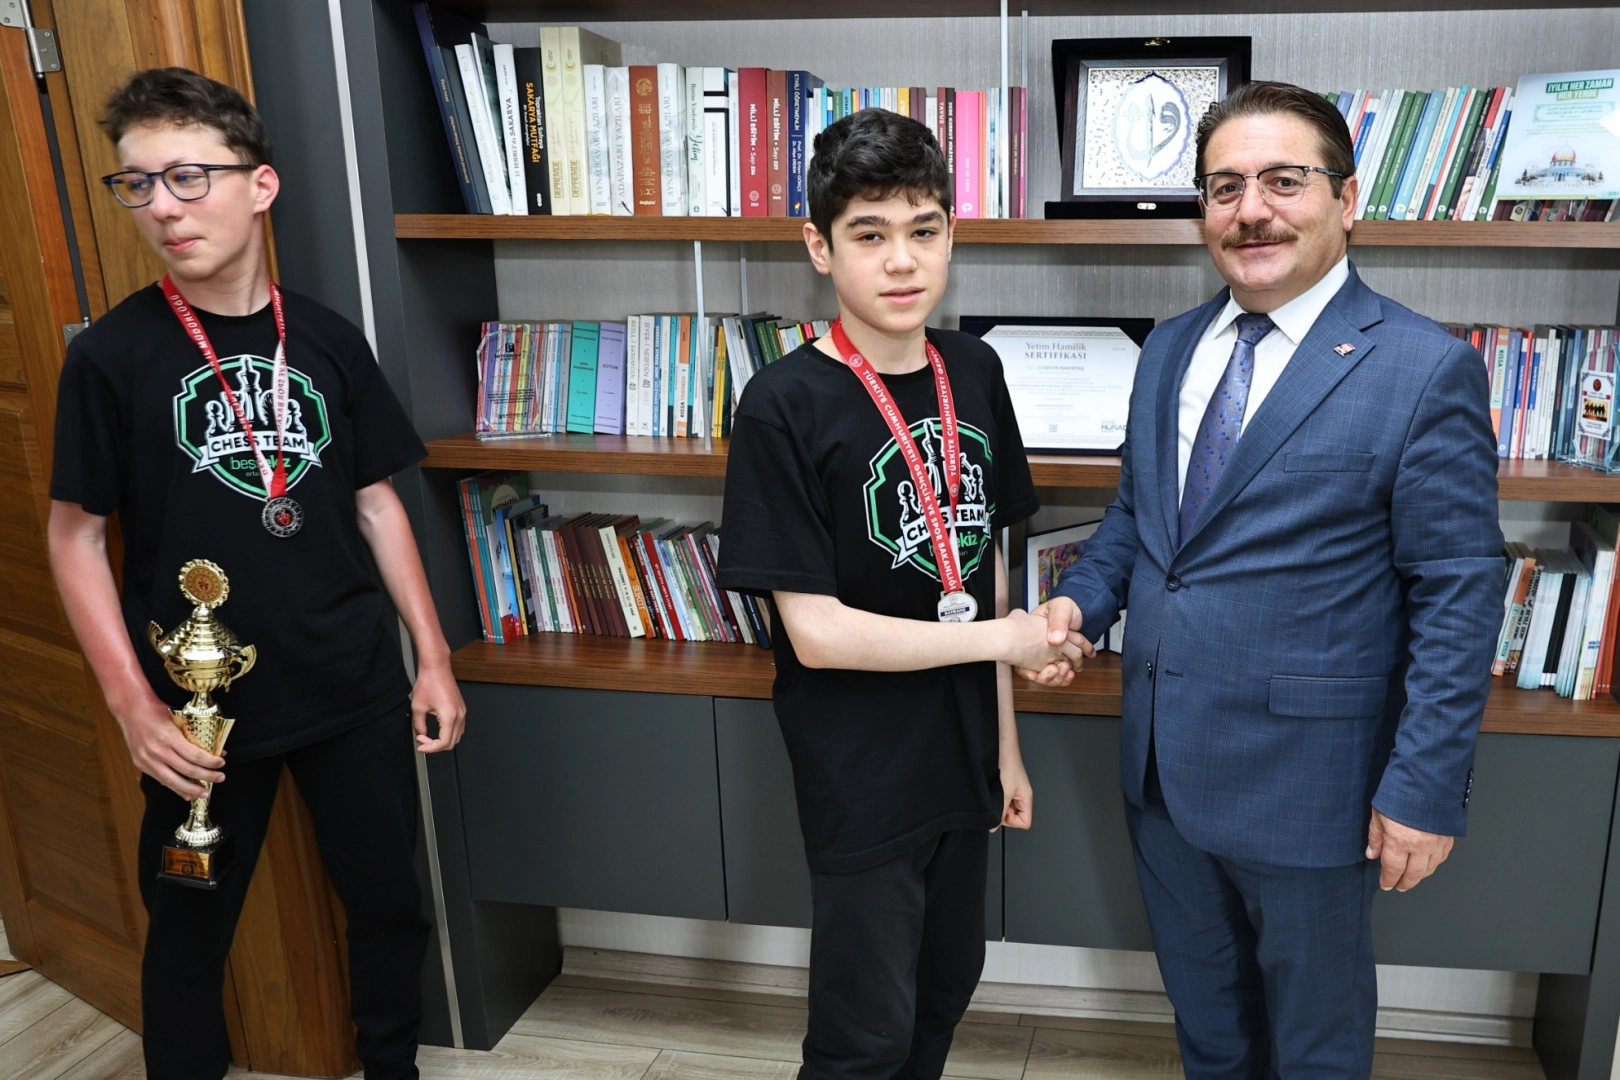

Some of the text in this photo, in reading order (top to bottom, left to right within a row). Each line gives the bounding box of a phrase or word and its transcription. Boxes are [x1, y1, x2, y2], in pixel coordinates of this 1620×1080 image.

[1569, 81, 1585, 91] HER
[1585, 79, 1613, 90] ZAMAN
[504, 96, 516, 136] SAKARYA
[523, 82, 541, 163] SAKARYA MUTFAĞI
[532, 95, 545, 149] Topraktan Sofraya
[591, 96, 605, 196] AYNALIKAVAK YAZILARI
[613, 96, 625, 197] ADAPAZARI YAZILARI
[662, 95, 675, 196] AYNALIKAVAK YAZILARI
[550, 160, 562, 199] DEPREMDE
[568, 159, 581, 198] DEPREMDE
[1024, 351, 1087, 359] SERTİFİKASI
[1026, 342, 1087, 350] Yetim Hamilik
[1496, 349, 1504, 367] KISSA
[1493, 367, 1503, 395] TADINDA
[937, 376, 953, 437] CUMHURİYETİ
[211, 434, 305, 452] CHESS TEAM
[945, 438, 957, 476] TÜRKİYE
[861, 367, 958, 589] TÜRKİYE CUMHURİYETİ GENÇLİK VE SPOR BAKANLIĞI
[1500, 615, 1516, 657] KISSA TADINDA
[1521, 608, 1531, 625] BEYAZ
